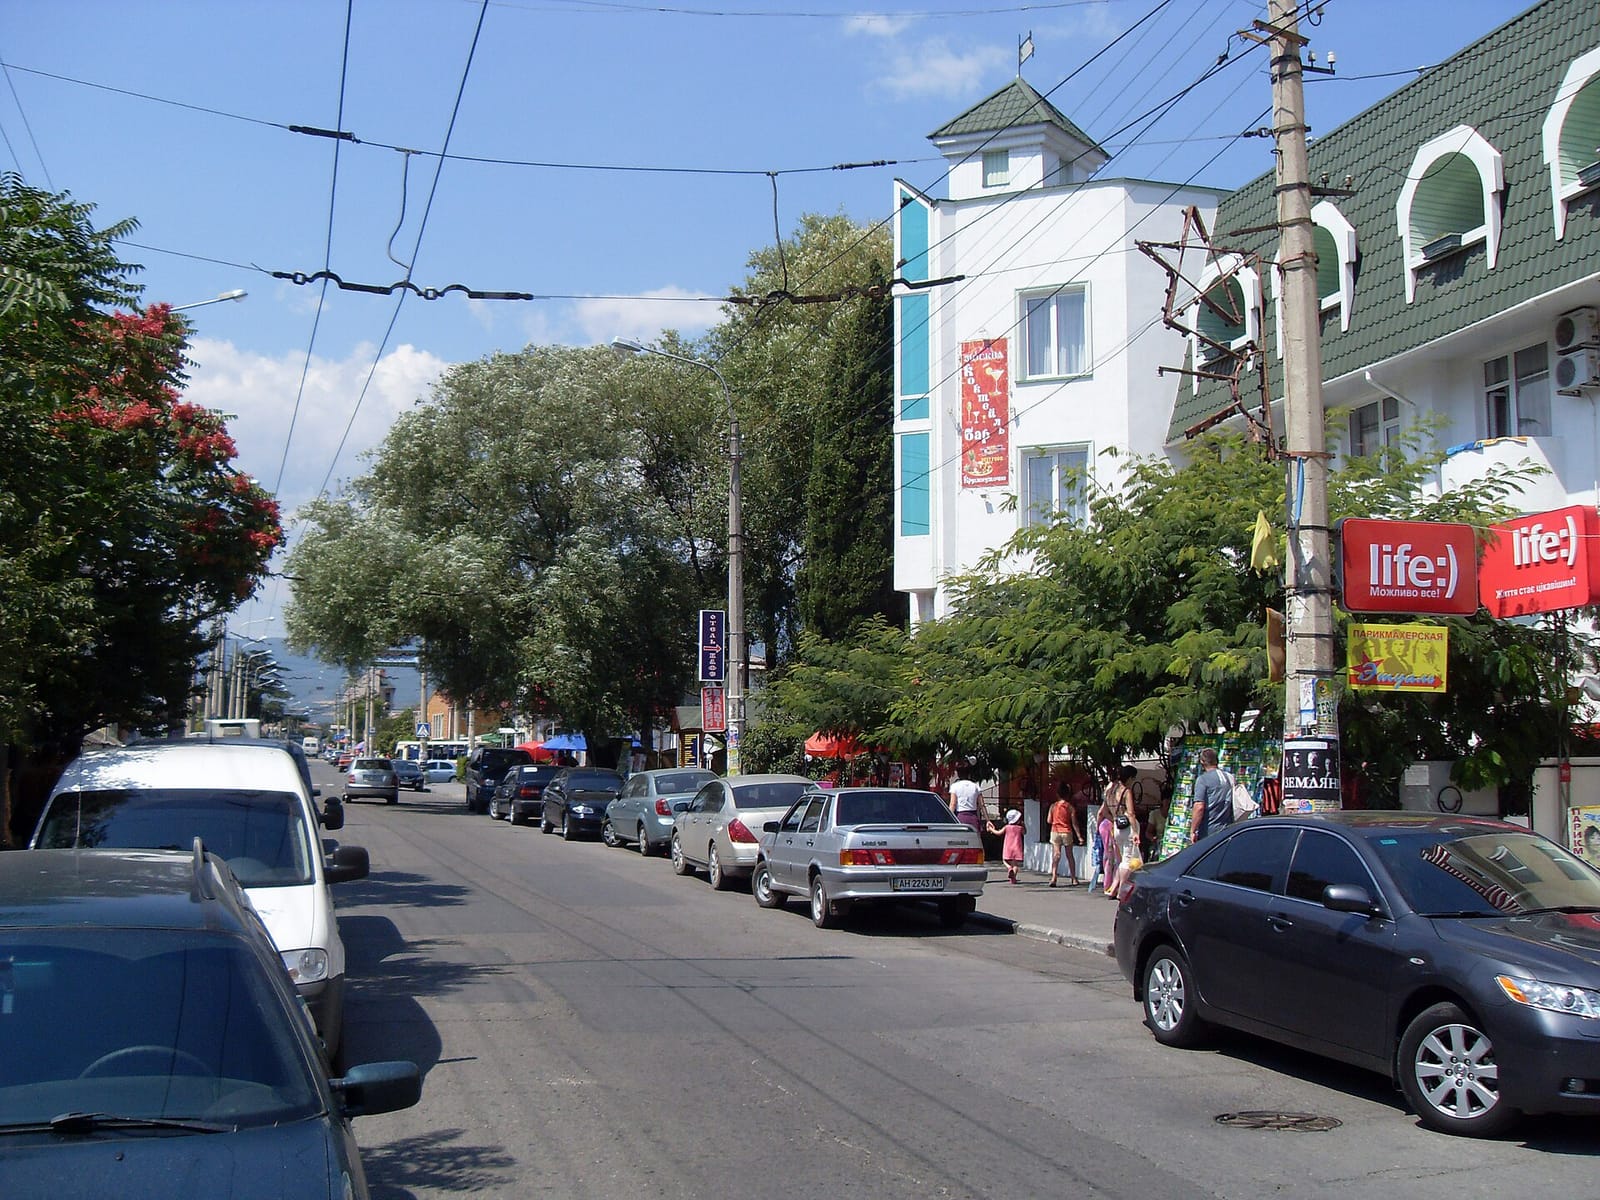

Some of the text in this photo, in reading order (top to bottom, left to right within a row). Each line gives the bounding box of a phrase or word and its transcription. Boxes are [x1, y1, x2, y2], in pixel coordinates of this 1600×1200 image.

[1512, 515, 1577, 566] life:)
[1369, 543, 1459, 599] life:)
[1370, 586, 1440, 598] Можливо все!
[1353, 629, 1443, 640] ПАРИКМАХЕРСКАЯ
[1284, 776, 1339, 789] ЗЕМЛЯН
[912, 878, 930, 888] 2243
